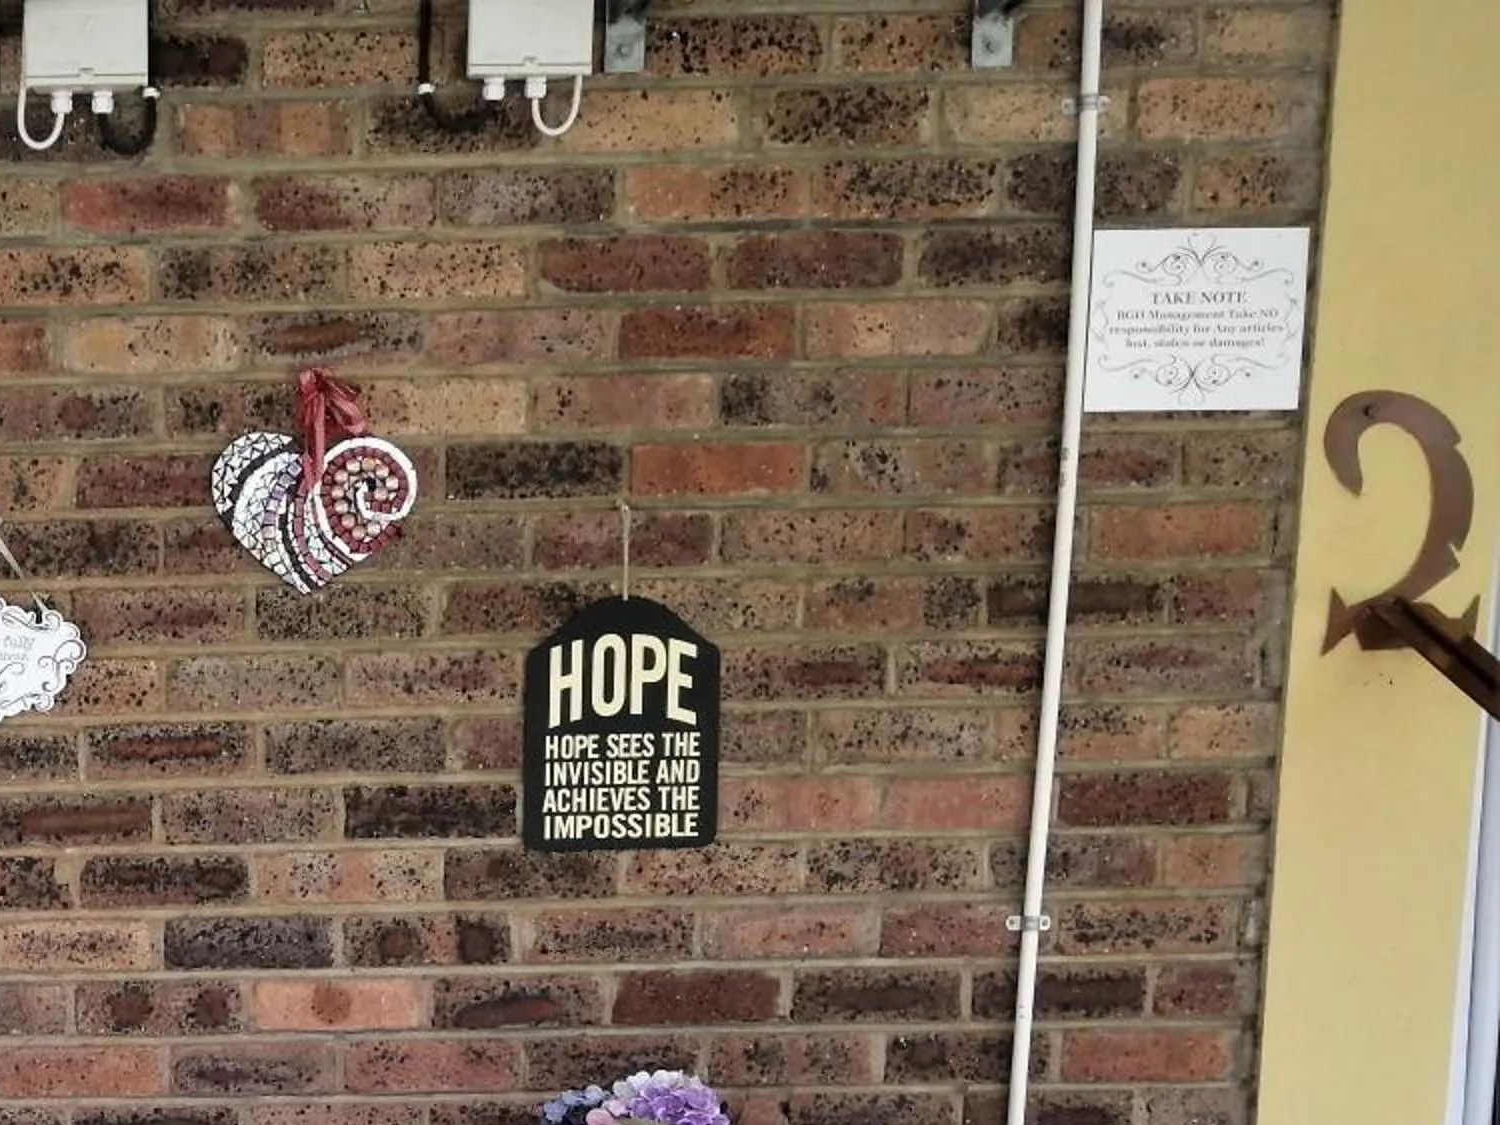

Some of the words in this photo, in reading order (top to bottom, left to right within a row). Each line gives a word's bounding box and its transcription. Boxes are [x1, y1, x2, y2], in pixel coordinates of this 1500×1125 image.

[1151, 291, 1194, 305] TAKE
[1200, 290, 1250, 305] NOTE
[1149, 309, 1224, 322] Management
[1260, 308, 1279, 319] NO
[1193, 323, 1210, 334] for
[1239, 322, 1284, 334] articles
[2, 634, 36, 650] fully
[548, 633, 698, 729] HOPE
[545, 734, 600, 760] HOPE
[606, 733, 655, 758] SEES
[662, 732, 701, 757] THE
[544, 760, 650, 786] INVISIBLE
[656, 759, 701, 784] AND
[542, 786, 651, 813] ACHIEVES
[658, 785, 700, 811] THE
[543, 813, 699, 840] IMPOSSIBLE
